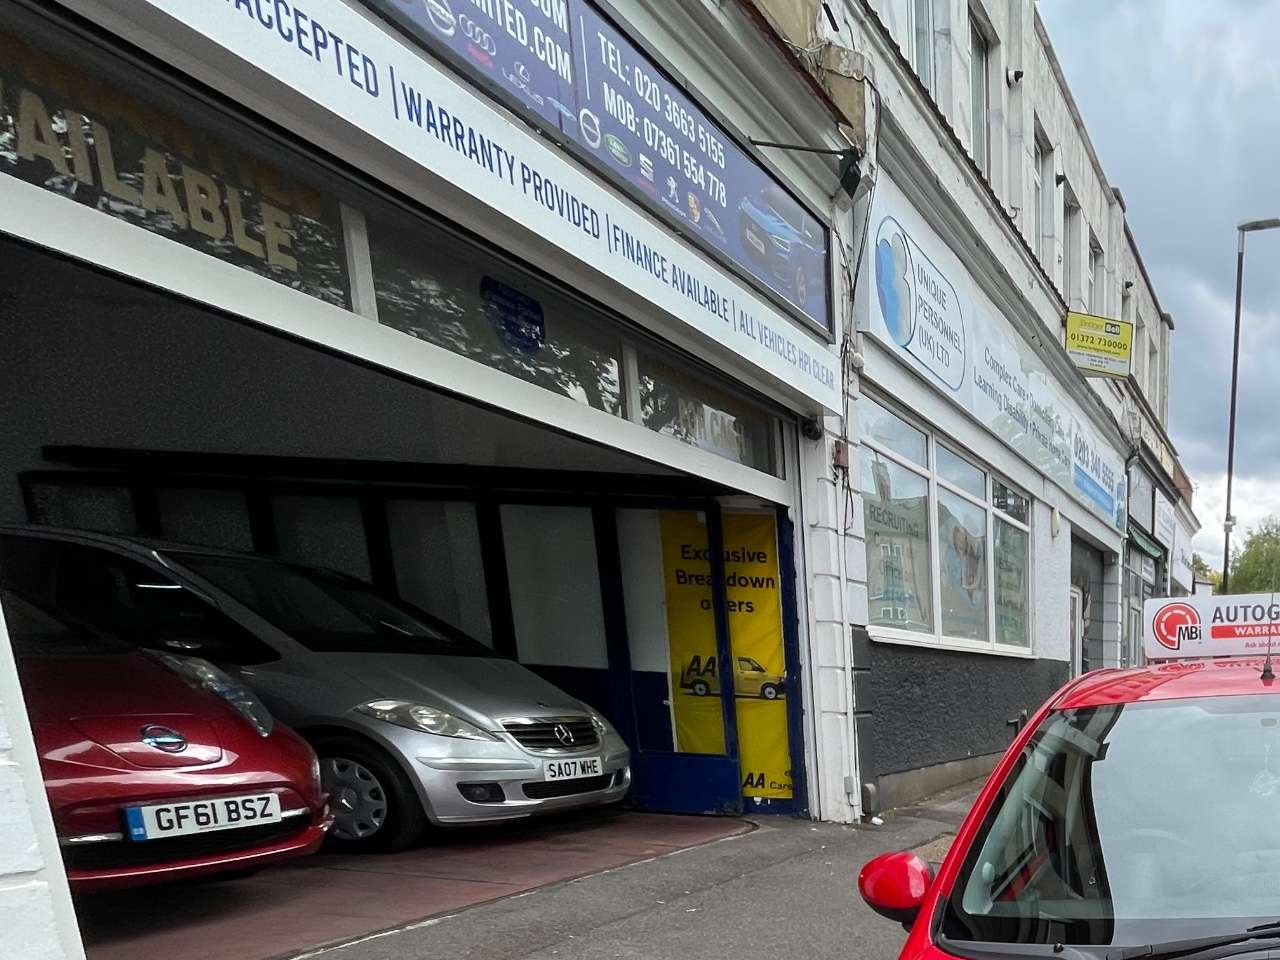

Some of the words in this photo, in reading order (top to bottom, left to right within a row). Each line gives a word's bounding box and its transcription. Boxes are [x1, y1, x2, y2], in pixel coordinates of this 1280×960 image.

[597, 32, 630, 87] TEL:
[634, 66, 661, 112] 020
[664, 93, 695, 143] 3663
[698, 124, 726, 170] 5155
[603, 82, 641, 138] MOB:
[643, 117, 681, 171] 07361
[682, 149, 705, 191] 554
[706, 170, 727, 208] 778
[234, 0, 380, 98] ACCEPTED
[401, 81, 515, 186] WARRANTY
[520, 162, 601, 240] PROVIDED
[613, 223, 669, 285] FINANCE
[672, 263, 729, 322] AVAILABLE
[740, 309, 757, 340] ALL
[757, 321, 798, 366] VEHICLES
[798, 347, 812, 376] HPI
[812, 360, 835, 391] CLEAR
[917, 263, 947, 311] UNIQUE
[918, 294, 963, 354] PERSONNEL
[1070, 332, 1095, 345] 01372
[1097, 337, 1128, 351] 730000
[918, 324, 935, 361] (UK)
[936, 341, 950, 369] LTD
[984, 346, 1012, 389] Complex
[1012, 375, 1026, 401] Care
[973, 366, 1003, 412] Learning
[1003, 394, 1029, 434] Disability
[681, 544, 768, 563] Excusive
[675, 569, 776, 589] Breadown
[700, 598, 755, 613] oers
[686, 654, 716, 678] AA
[548, 761, 577, 778] SA07
[579, 759, 599, 775] WHE
[742, 772, 765, 789] AA
[154, 802, 219, 832] GF61
[224, 796, 274, 823] BSZ
